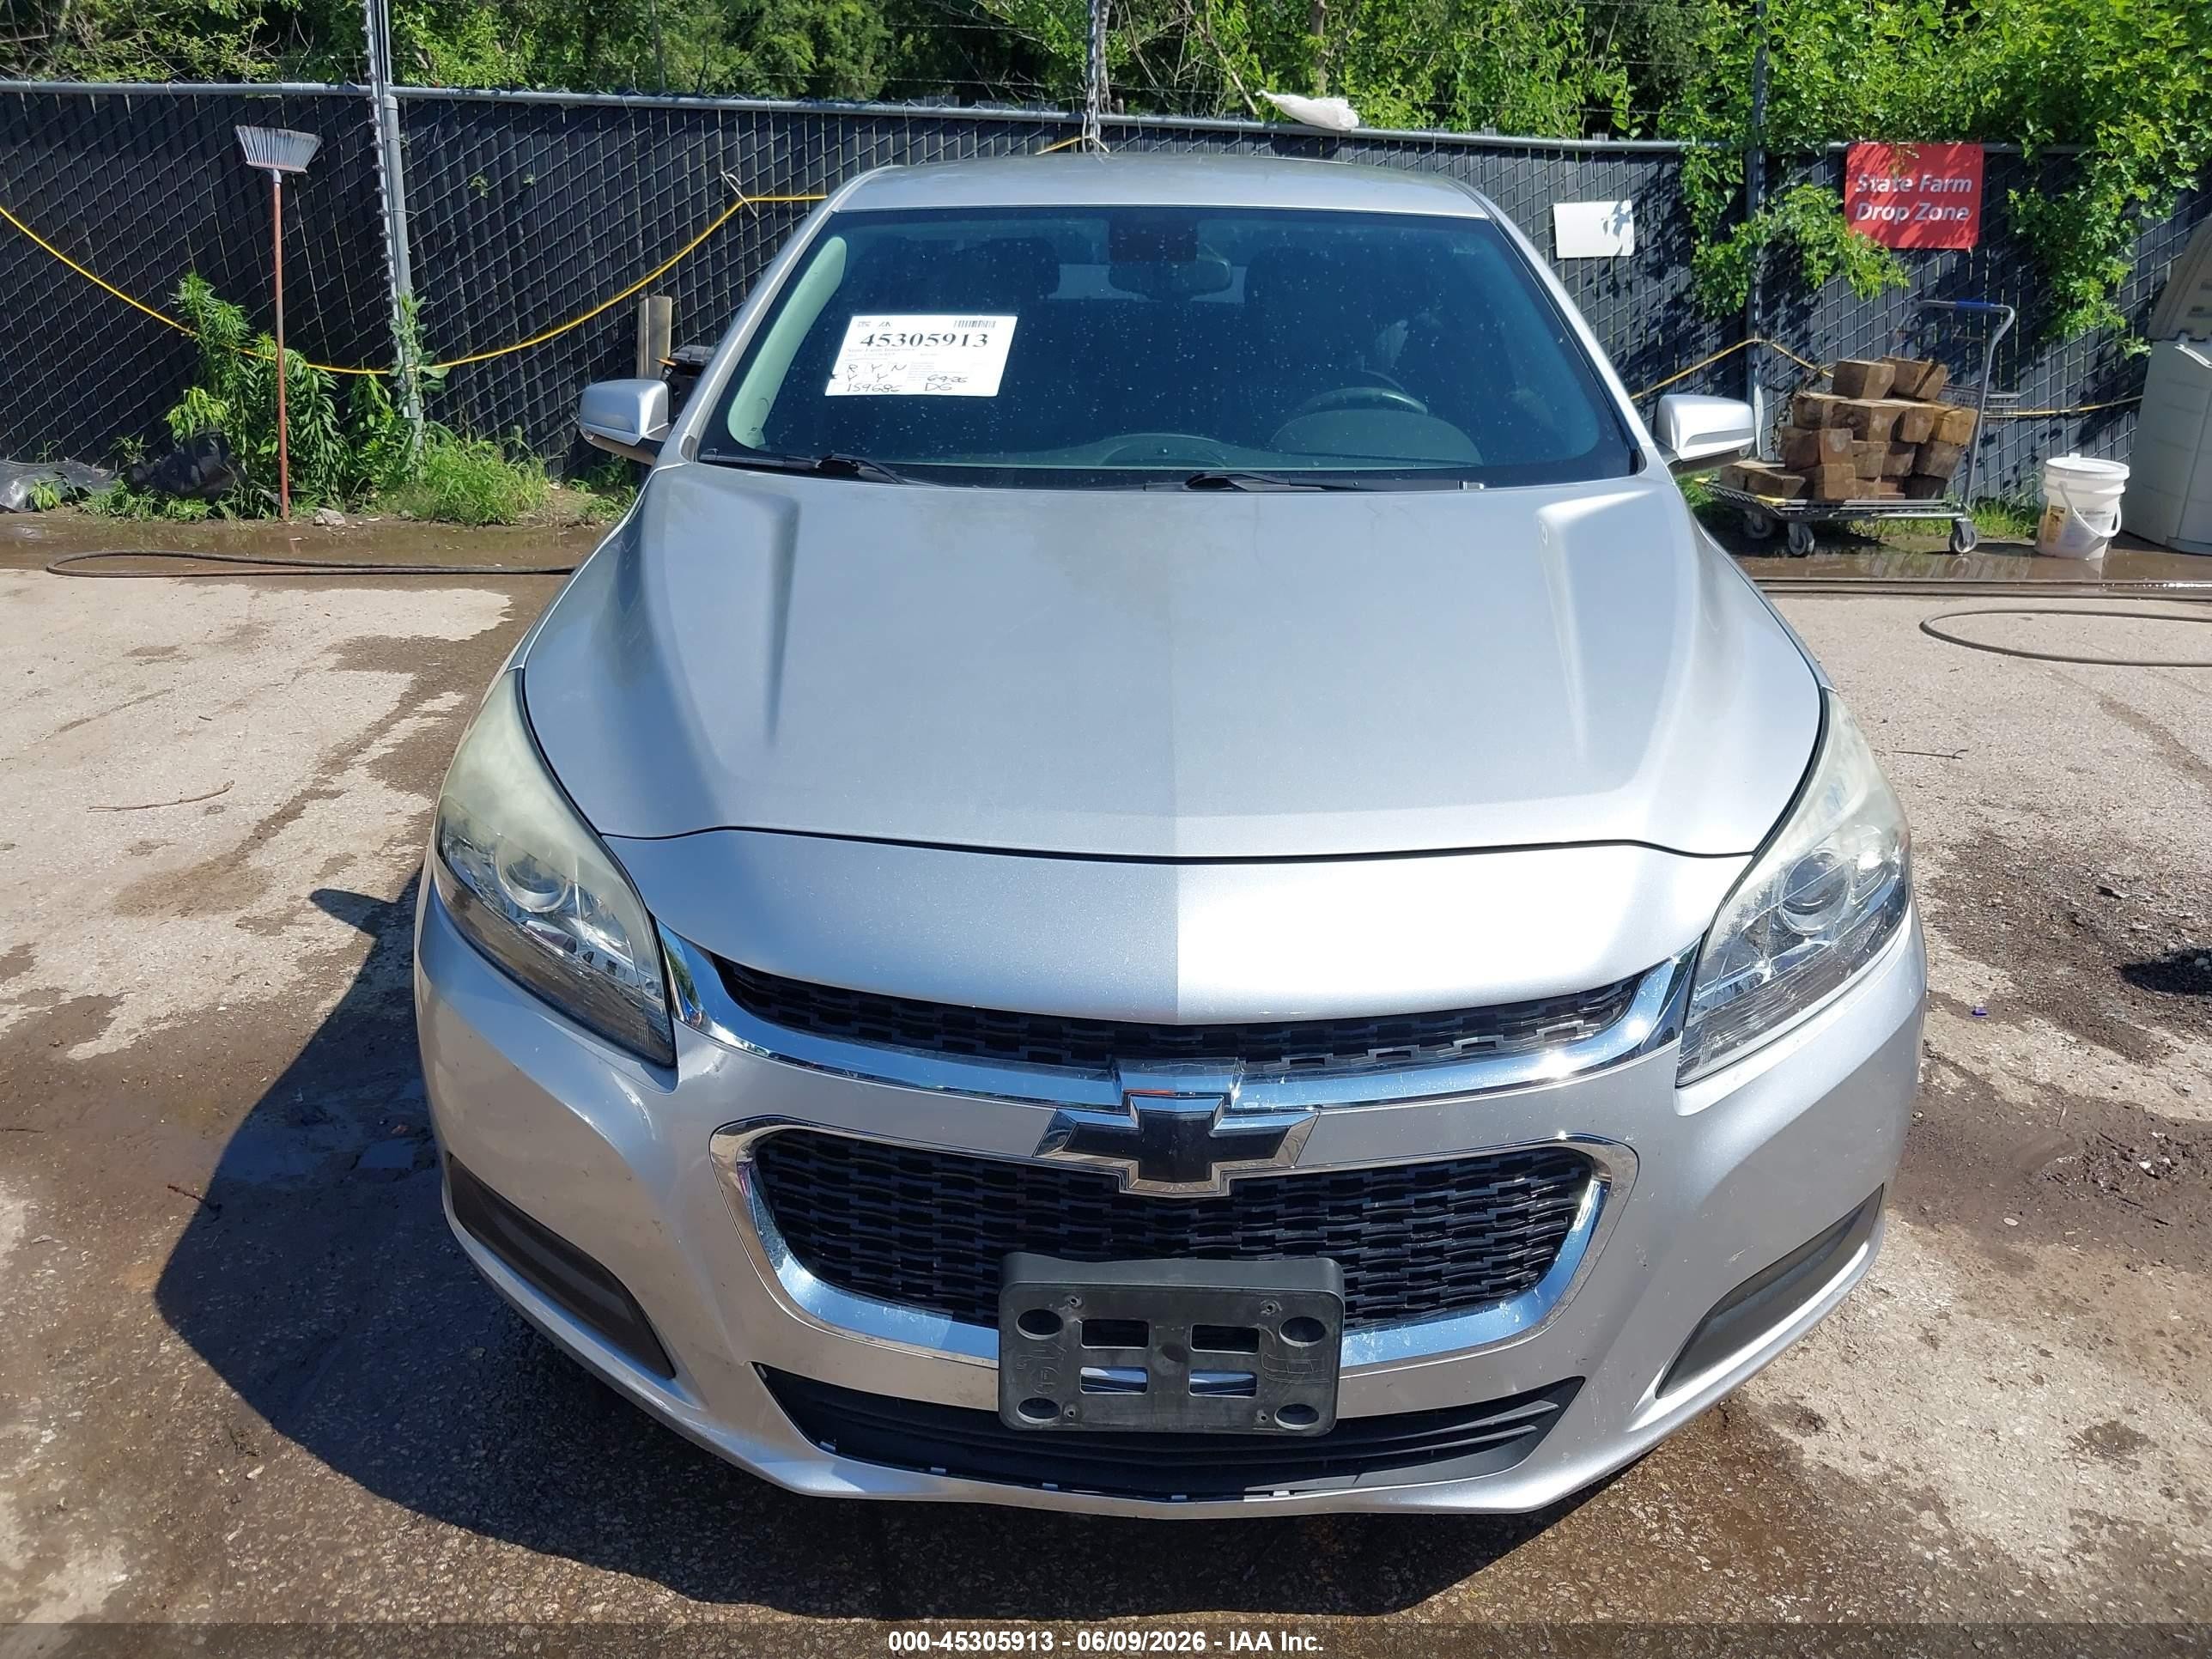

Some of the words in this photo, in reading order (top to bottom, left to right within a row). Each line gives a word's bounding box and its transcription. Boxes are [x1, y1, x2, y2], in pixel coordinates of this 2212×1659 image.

[1855, 173, 1914, 193] State
[1918, 173, 1972, 193] Farm
[1855, 202, 1910, 225] Drop
[1915, 202, 1970, 221] Zone
[860, 332, 988, 348] 45305913
